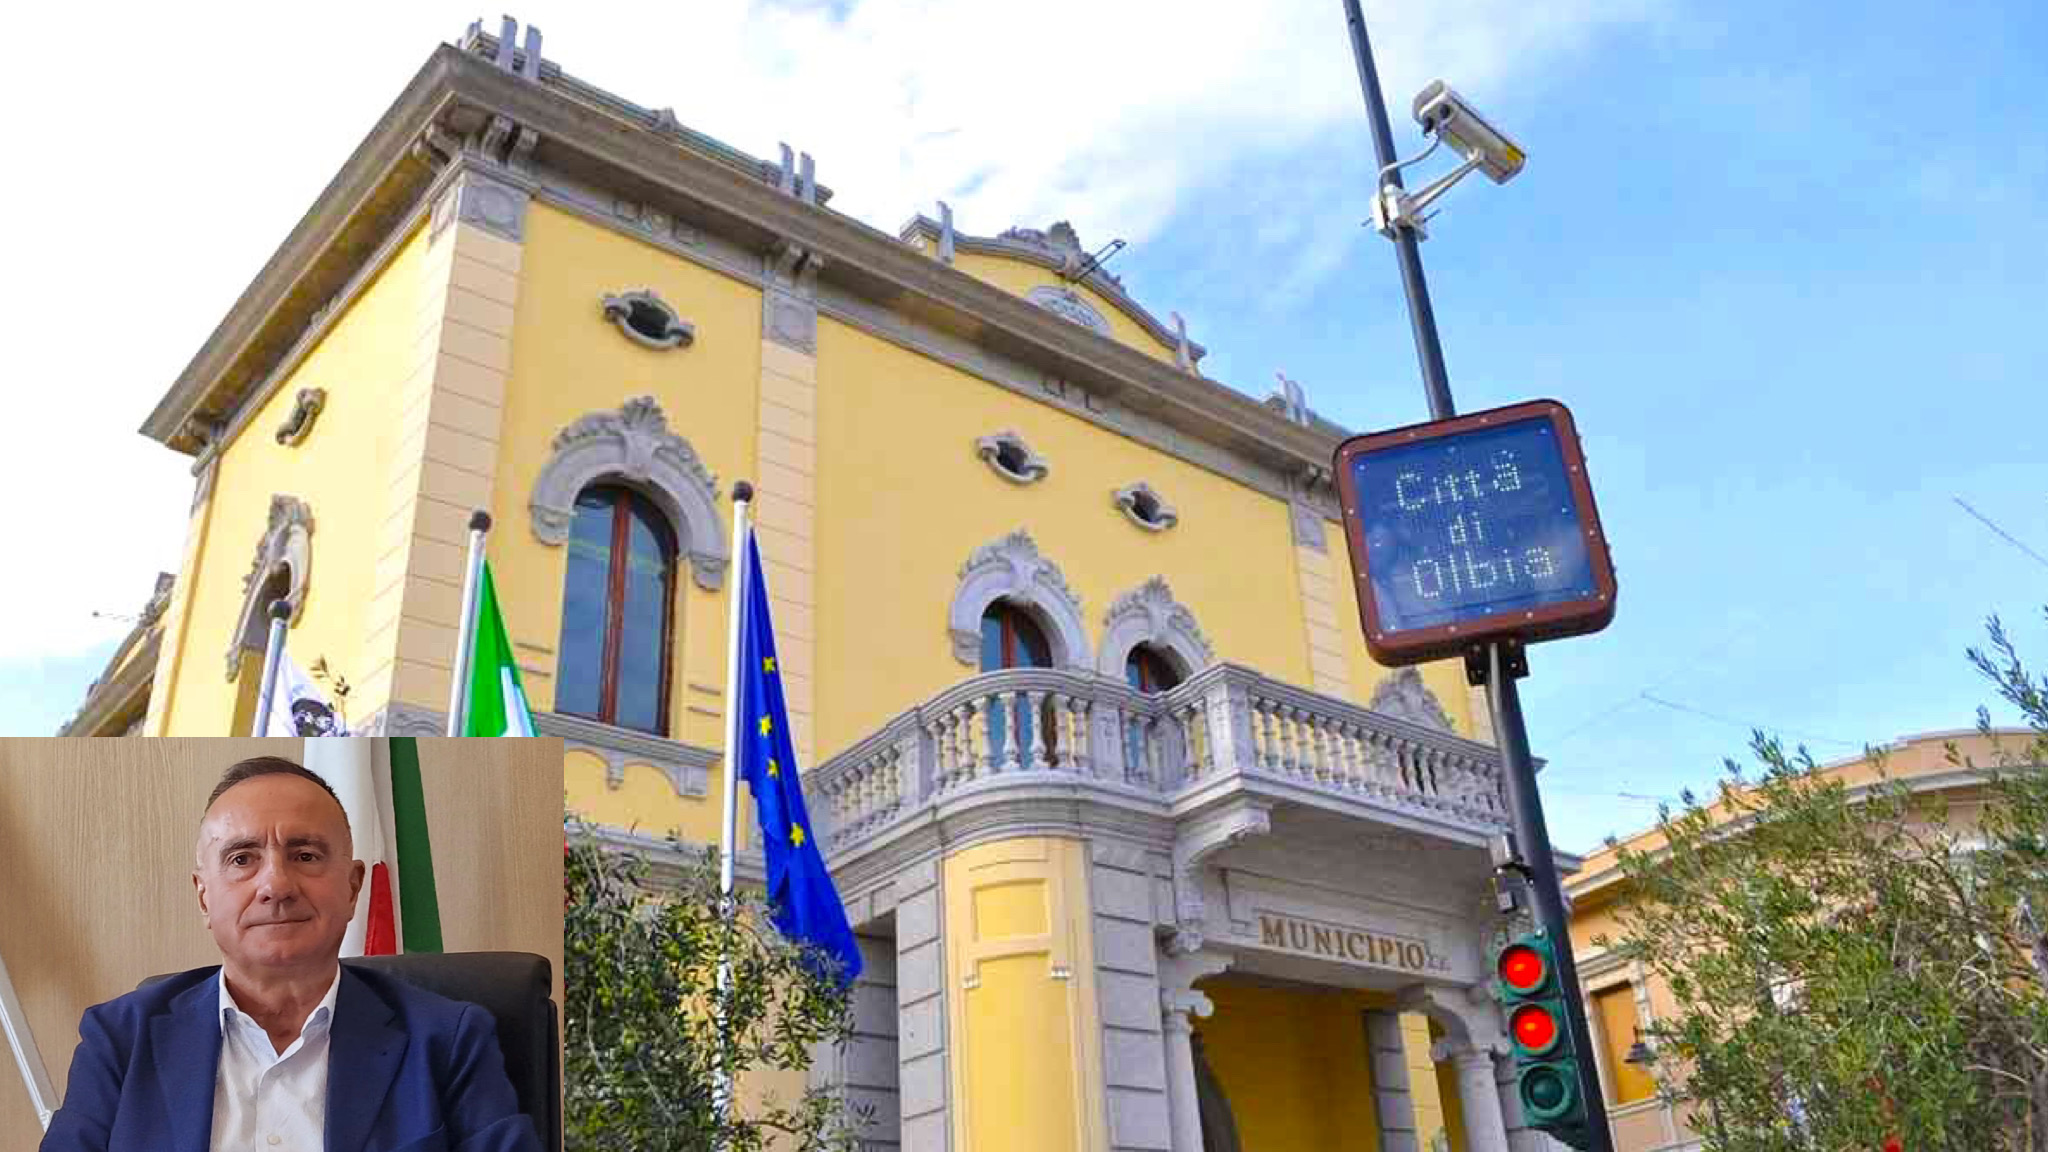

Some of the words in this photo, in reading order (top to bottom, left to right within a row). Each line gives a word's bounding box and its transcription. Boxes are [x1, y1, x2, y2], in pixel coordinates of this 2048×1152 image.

[1449, 511, 1483, 544] di
[1412, 546, 1553, 598] Olbia
[1259, 915, 1424, 970] MUNICIPIO
